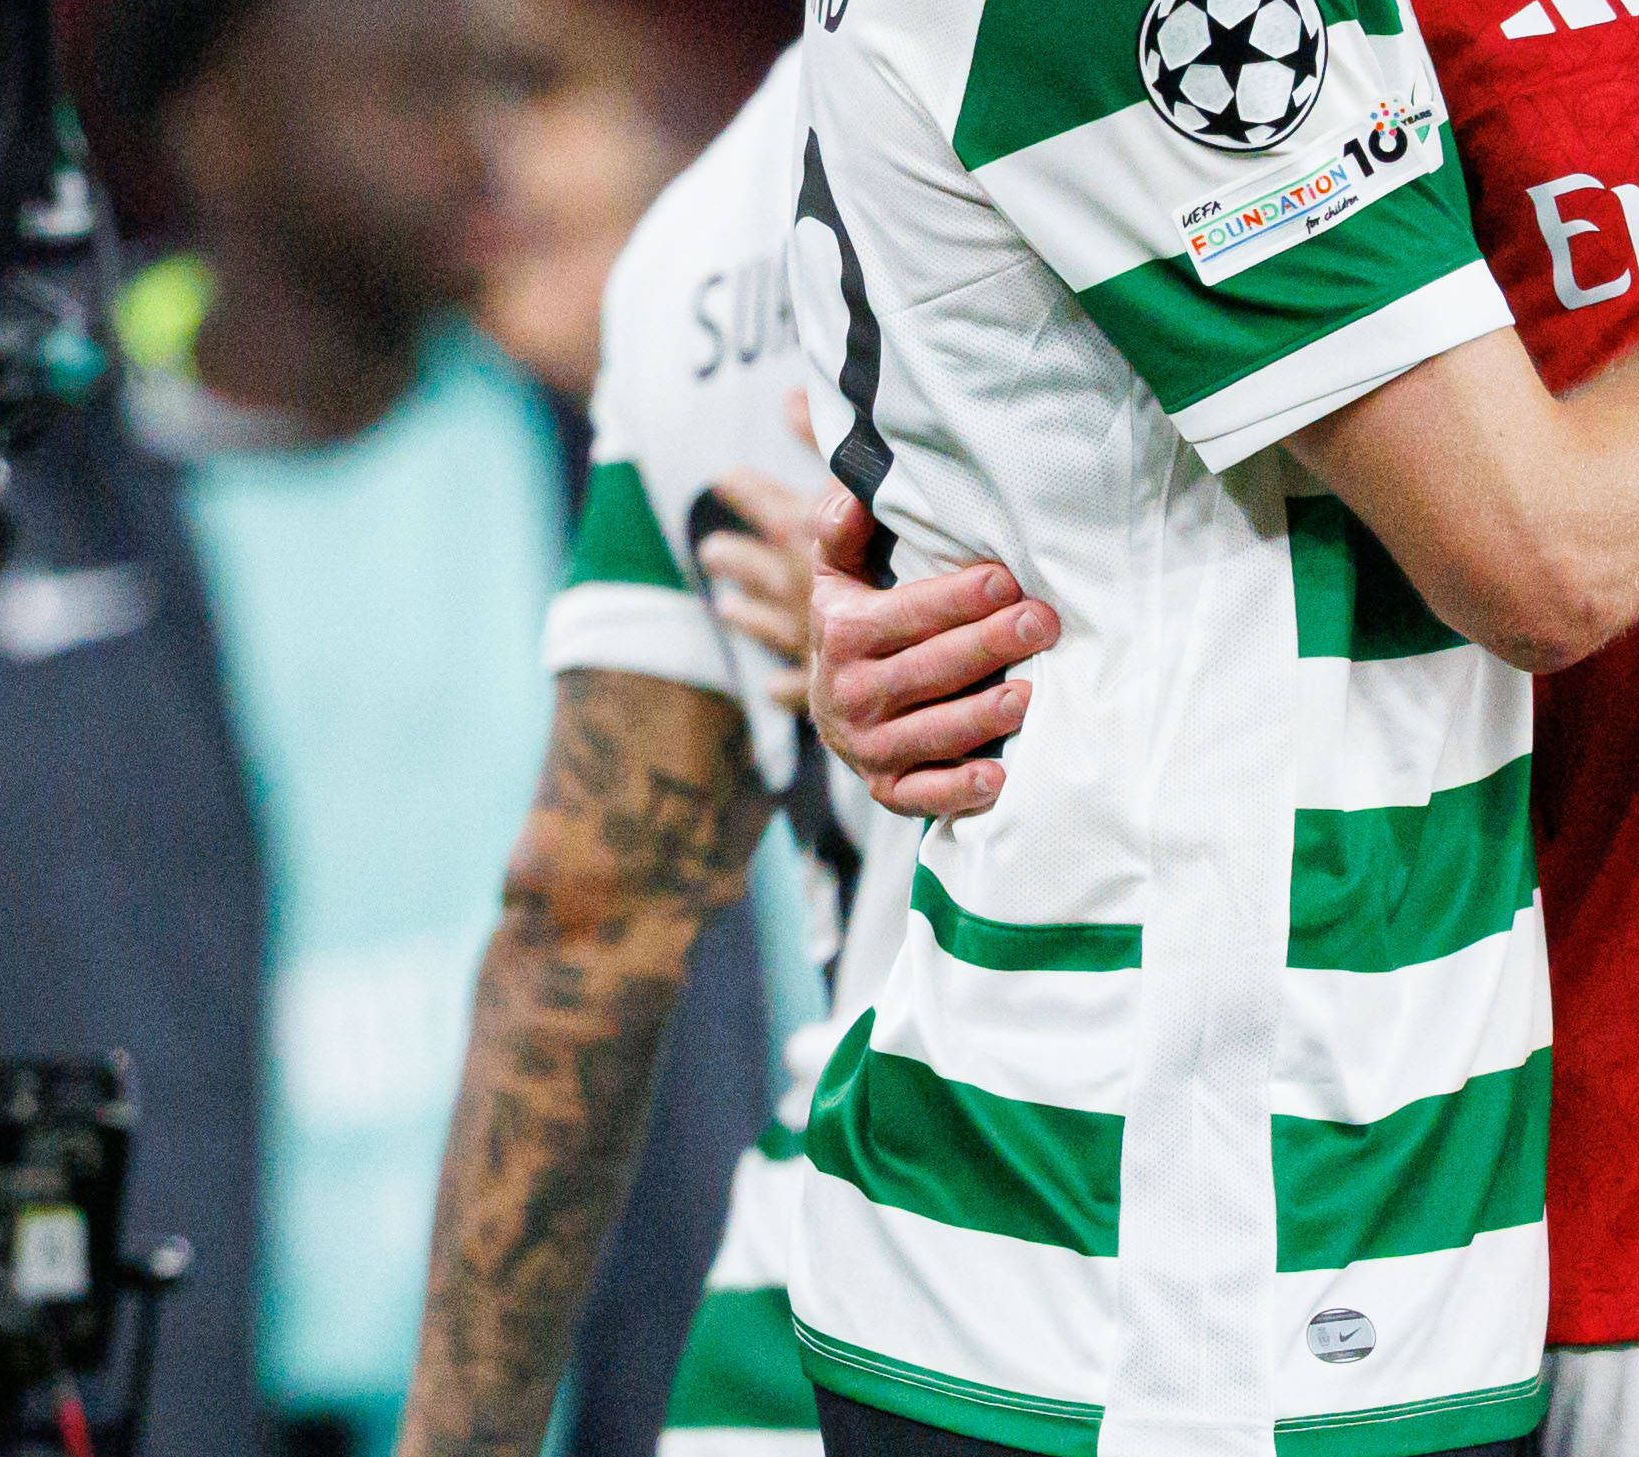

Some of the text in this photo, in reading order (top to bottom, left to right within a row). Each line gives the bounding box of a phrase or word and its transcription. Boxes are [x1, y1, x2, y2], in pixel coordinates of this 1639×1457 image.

[1343, 126, 1408, 178] 10
[1182, 200, 1222, 228] UEFA
[1305, 193, 1360, 234] for children
